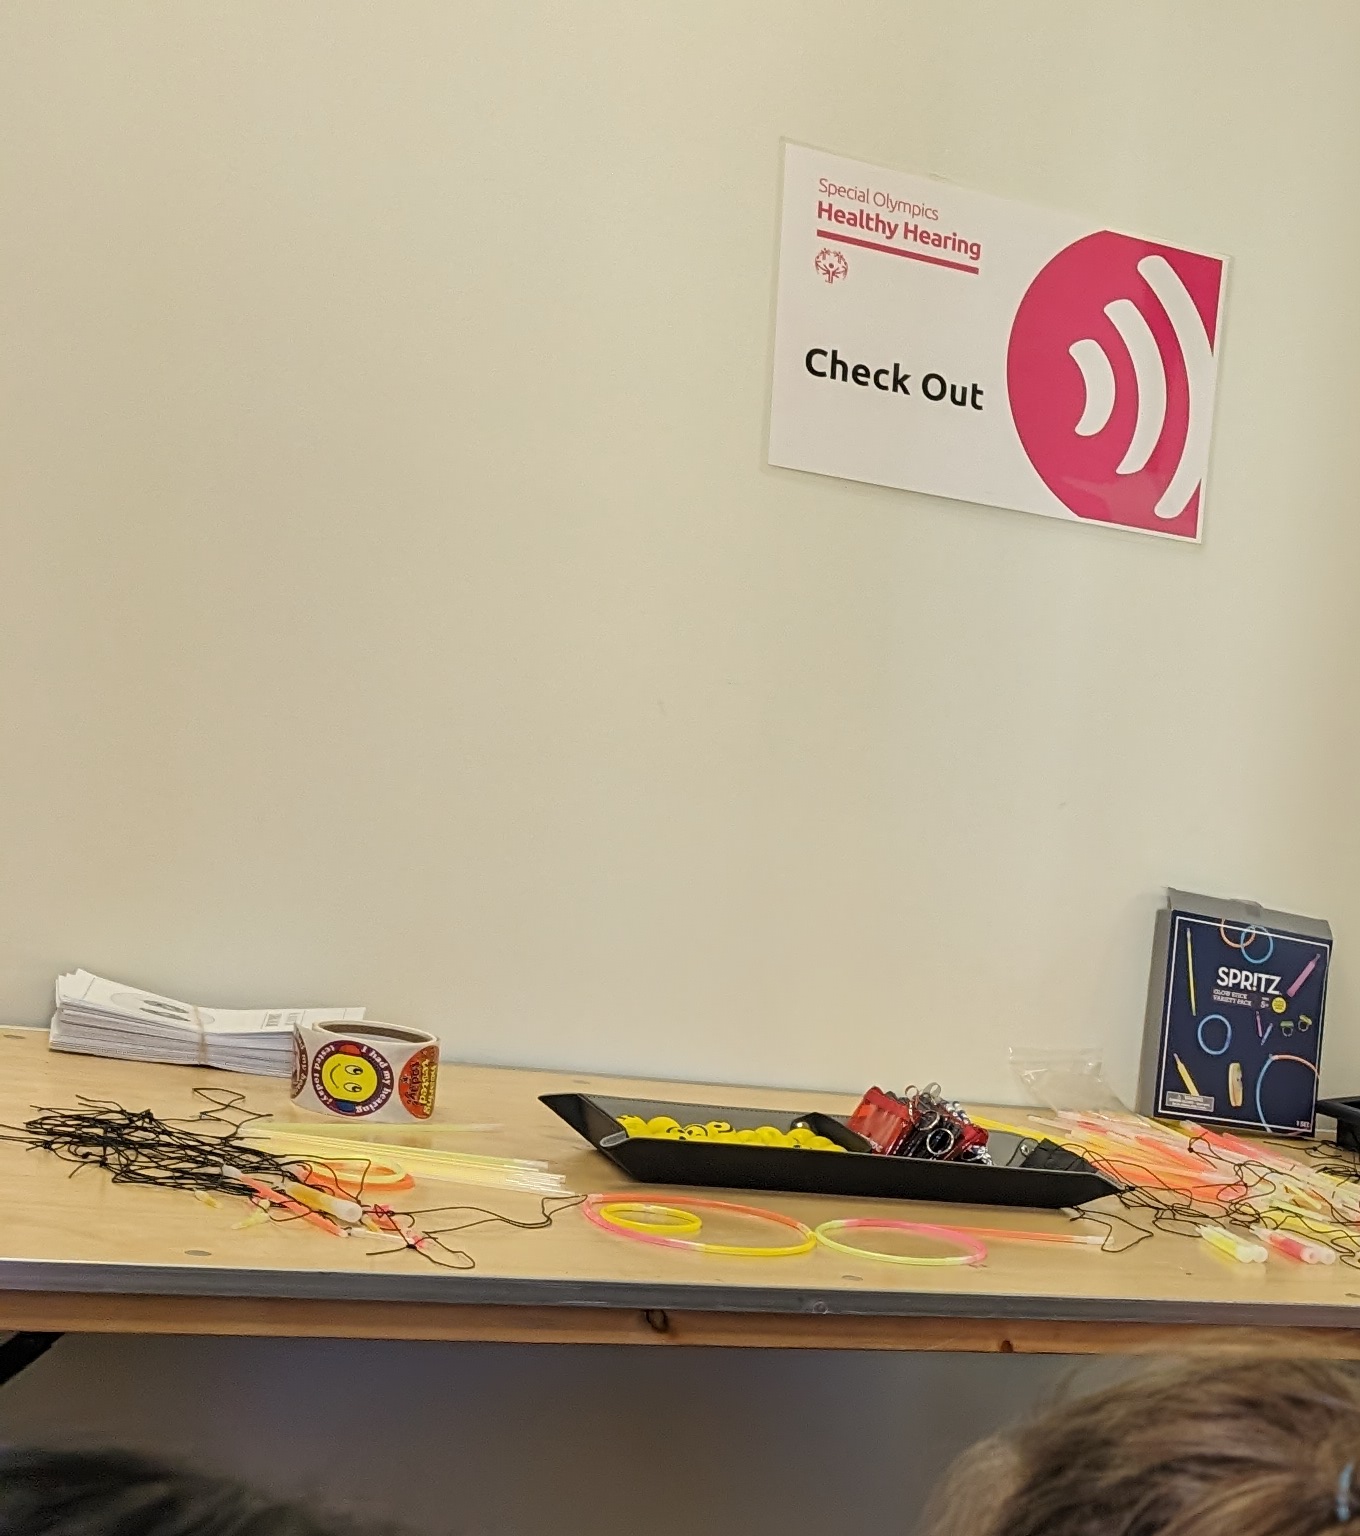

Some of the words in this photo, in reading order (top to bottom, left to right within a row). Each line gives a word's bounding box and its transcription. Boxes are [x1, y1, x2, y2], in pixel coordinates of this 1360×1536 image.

[818, 178, 870, 205] Special
[873, 191, 939, 222] Olympics
[816, 200, 899, 240] Healthy
[903, 221, 982, 262] Hearing
[805, 348, 911, 396] Check
[921, 371, 985, 411] Out
[314, 1044, 335, 1070] tested
[369, 1050, 387, 1070] had
[383, 1071, 392, 1087] my
[355, 1088, 392, 1114] hearing
